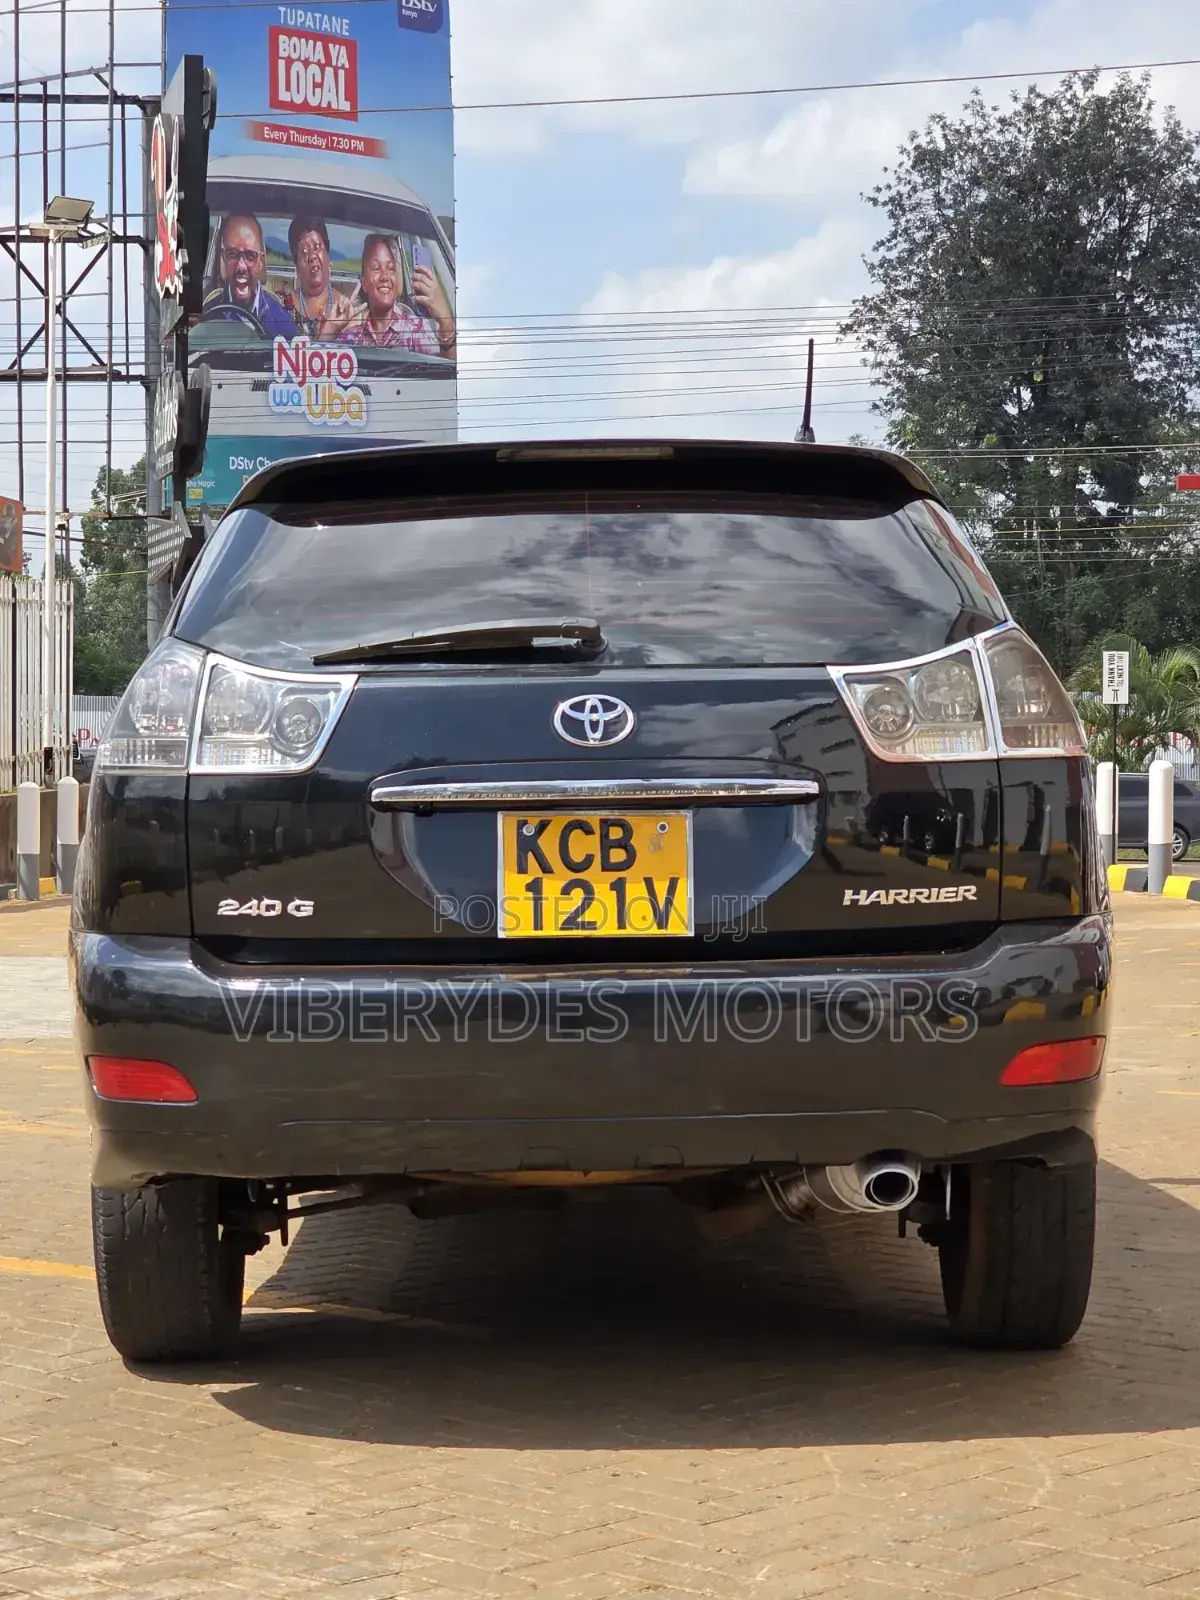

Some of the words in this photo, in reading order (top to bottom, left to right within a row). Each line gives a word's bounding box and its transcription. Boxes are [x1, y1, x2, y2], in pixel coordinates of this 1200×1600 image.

[278, 6, 350, 36] TUPATANE
[278, 34, 326, 64] BOMA
[328, 43, 350, 68] YA
[278, 58, 351, 111] LOCAL
[264, 126, 288, 143] Every
[289, 130, 328, 149] Thursday
[351, 139, 365, 152] PM
[277, 341, 354, 387] Njoro
[273, 388, 301, 406] wa
[307, 382, 363, 420] Uba
[229, 456, 254, 470] DStv
[1107, 653, 1115, 666] YOU
[1107, 667, 1115, 688] THANK
[516, 818, 637, 875] KCB
[217, 897, 282, 917] 240
[286, 900, 315, 917] G
[524, 876, 680, 932] 121V
[842, 885, 978, 907] HARRIER
